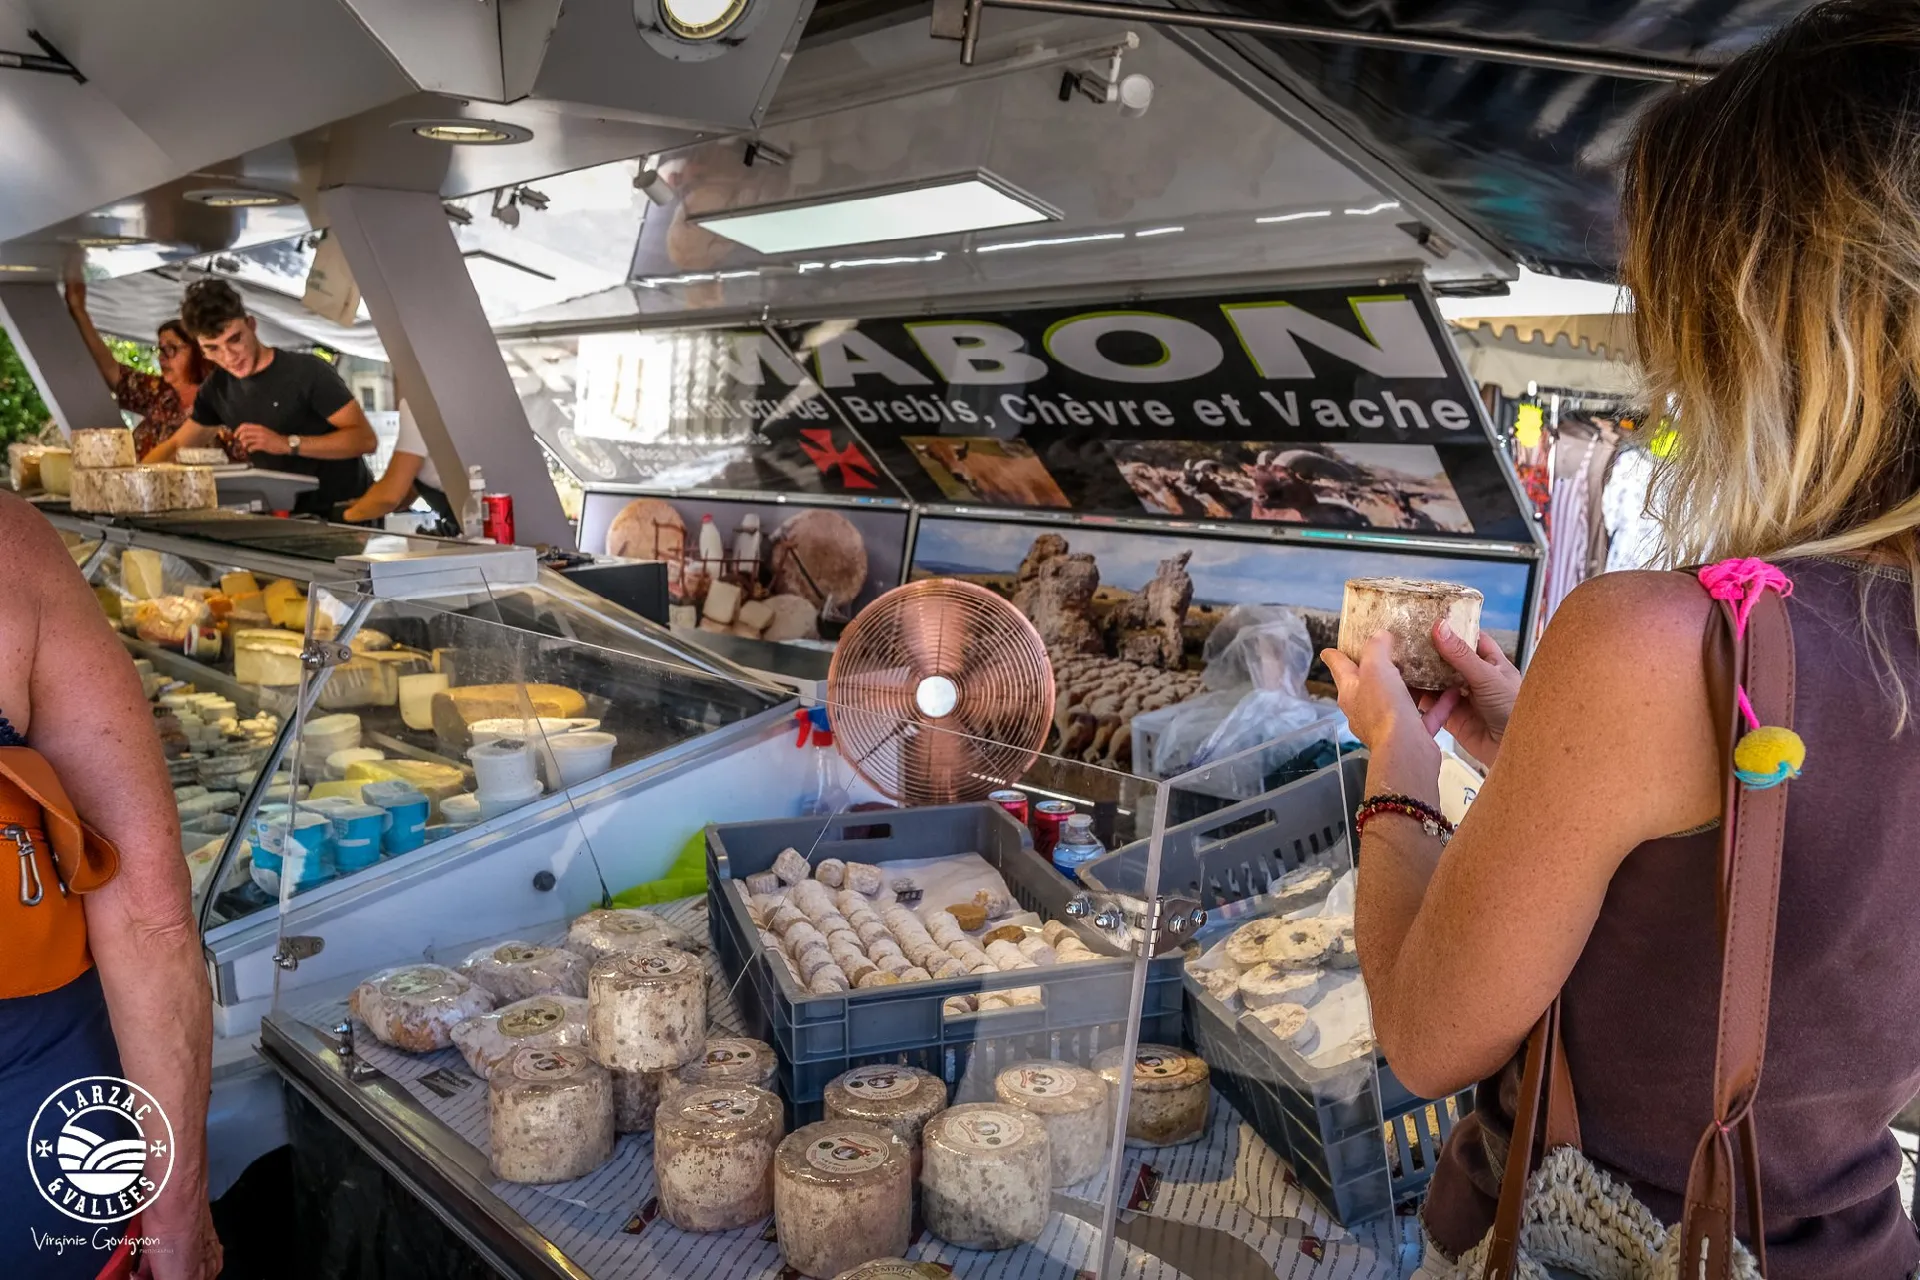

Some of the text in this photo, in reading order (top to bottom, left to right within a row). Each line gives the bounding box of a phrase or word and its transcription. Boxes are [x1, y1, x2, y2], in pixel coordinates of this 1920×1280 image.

[790, 394, 830, 421] de
[841, 394, 996, 429] Brebis,
[1000, 393, 1175, 427] Chèvre
[1193, 394, 1251, 427] et
[1260, 390, 1471, 430] Vache
